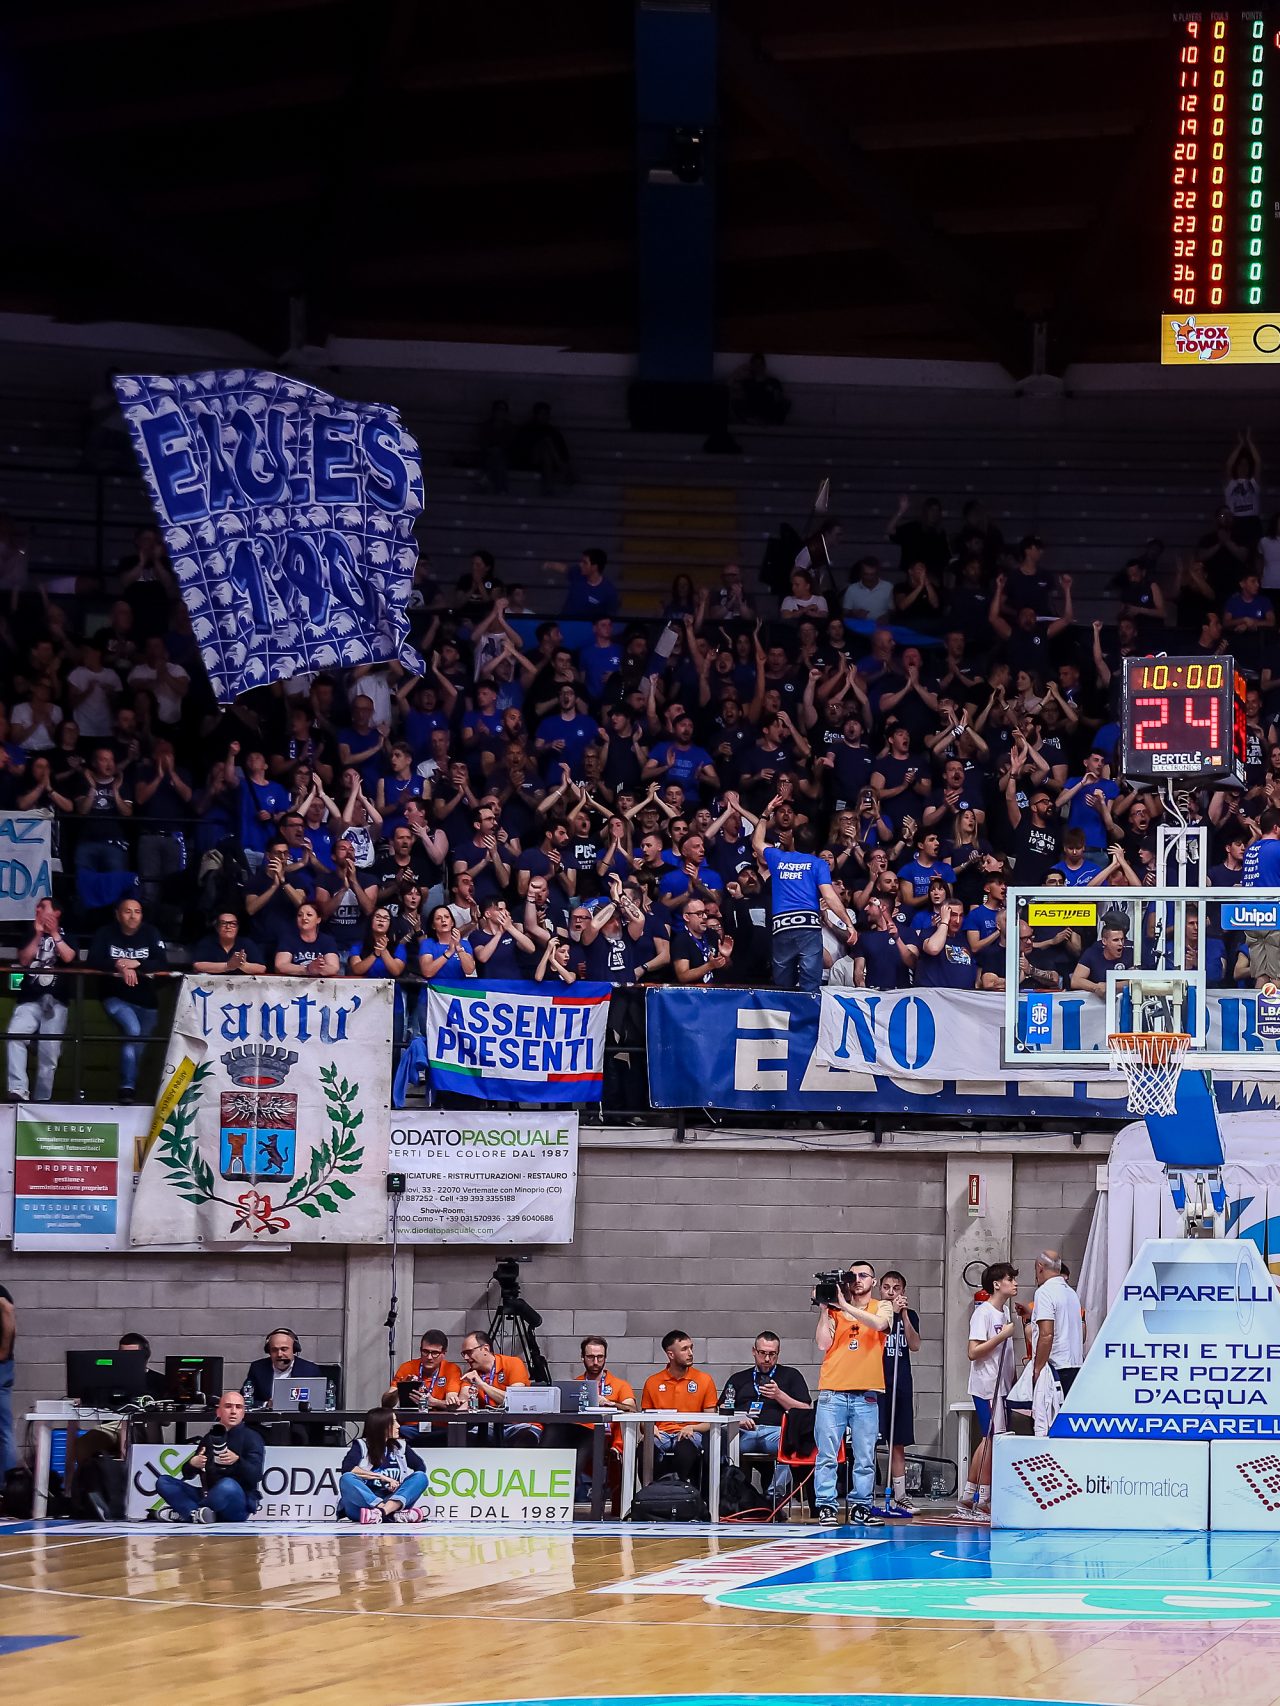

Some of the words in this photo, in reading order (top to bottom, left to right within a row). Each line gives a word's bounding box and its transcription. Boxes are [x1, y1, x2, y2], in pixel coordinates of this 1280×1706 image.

[1187, 21, 1198, 39] 9
[1181, 46, 1198, 64] 10
[1181, 71, 1198, 87] 11
[1181, 94, 1198, 112] 12
[1180, 118, 1197, 136] 19
[1174, 143, 1197, 161] 20
[1174, 167, 1197, 185] 21
[1173, 191, 1197, 209] 22
[1173, 215, 1196, 233] 23
[1174, 239, 1196, 257] 32
[1173, 264, 1195, 281] 36
[1173, 288, 1195, 305] 90
[1195, 327, 1228, 339] FOX
[1176, 339, 1229, 351] TOWN
[1142, 664, 1223, 690] 10:00
[1135, 697, 1219, 750] 24
[1152, 751, 1201, 764] BERTELÈ
[1034, 909, 1091, 921] FASTWEB
[1234, 906, 1277, 926] Unipol
[111, 945, 149, 960] EAGLES
[446, 998, 591, 1040] ASSENTI
[833, 994, 936, 1070] NO
[1029, 1027, 1050, 1035] FIP
[436, 1026, 594, 1072] PRESENTI
[47, 1125, 93, 1133] ENERGY
[456, 1150, 507, 1158] COLORE
[513, 1150, 536, 1158] DAL
[514, 1186, 545, 1195] Minoprio
[23, 1204, 109, 1212] OUTSOURCING
[1123, 1285, 1273, 1302] PAPARELLI
[1105, 1343, 1189, 1360] FILTRI
[1201, 1344, 1218, 1359] E
[1122, 1366, 1178, 1381] PER
[1190, 1367, 1271, 1382] POZZI
[1134, 1389, 1268, 1409] D'ACQUA
[470, 1505, 510, 1518] DAL
[521, 1505, 570, 1519] 1987
